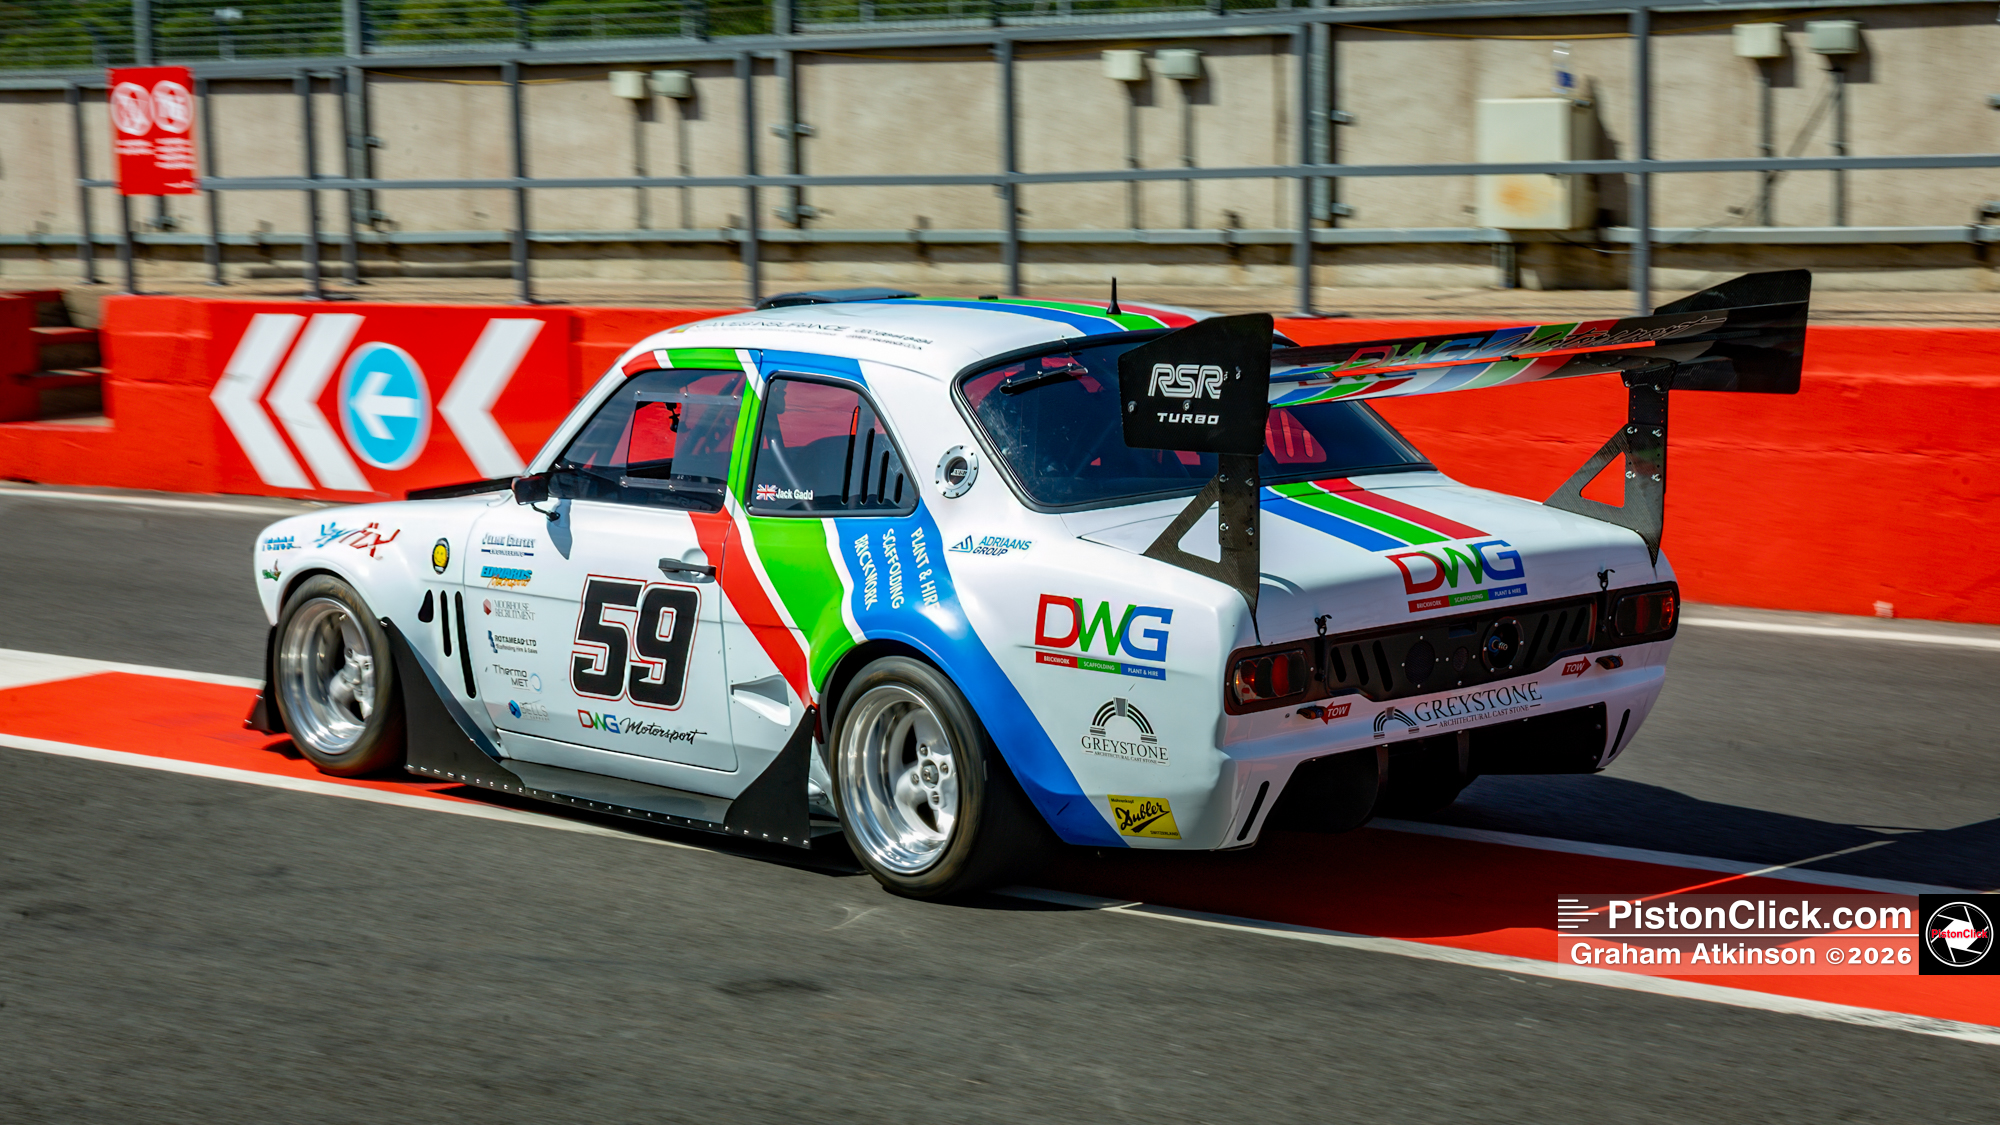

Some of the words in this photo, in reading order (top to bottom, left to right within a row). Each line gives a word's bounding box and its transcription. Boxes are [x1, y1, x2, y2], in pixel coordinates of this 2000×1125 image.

[1335, 336, 1485, 371] DWG
[1147, 363, 1223, 400] RSR
[1157, 412, 1220, 425] TURBO
[775, 488, 793, 499] Jack
[793, 489, 814, 500] Gadd
[910, 527, 930, 569] PLANT
[979, 536, 1032, 550] ADRIAANS
[972, 546, 1008, 556] GROUP
[481, 566, 533, 580] EDWARDS
[854, 533, 878, 611] BRICKWORK
[882, 528, 905, 609] SCAFFOLDING
[1384, 540, 1525, 595] DWG
[918, 568, 932, 582] &
[920, 580, 941, 610] HIRE
[1454, 593, 1484, 603] SCAFFOLDING
[1494, 589, 1507, 597] PLANT
[1416, 600, 1442, 609] BRICKWORK
[1035, 593, 1173, 662] DWG
[526, 639, 537, 647] LTD
[570, 574, 701, 711] 59
[1043, 655, 1070, 665] BRICKWORK
[1083, 661, 1115, 671] SCAFFOLDING
[492, 664, 527, 677] Thermo
[1127, 667, 1142, 675] PLANT
[1566, 662, 1586, 673] TOW
[511, 677, 528, 687] MET
[1414, 681, 1543, 722] GREYSTONE
[1327, 705, 1348, 718] TOW
[1439, 712, 1491, 728] ARCHITECTURAL
[1492, 708, 1508, 718] CAST
[1509, 704, 1529, 714] STONE
[577, 709, 621, 734] DWG
[619, 717, 707, 744] Motorsport
[1081, 735, 1169, 761] GREYSTONE
[1094, 751, 1130, 761] ARCHITECTURAL
